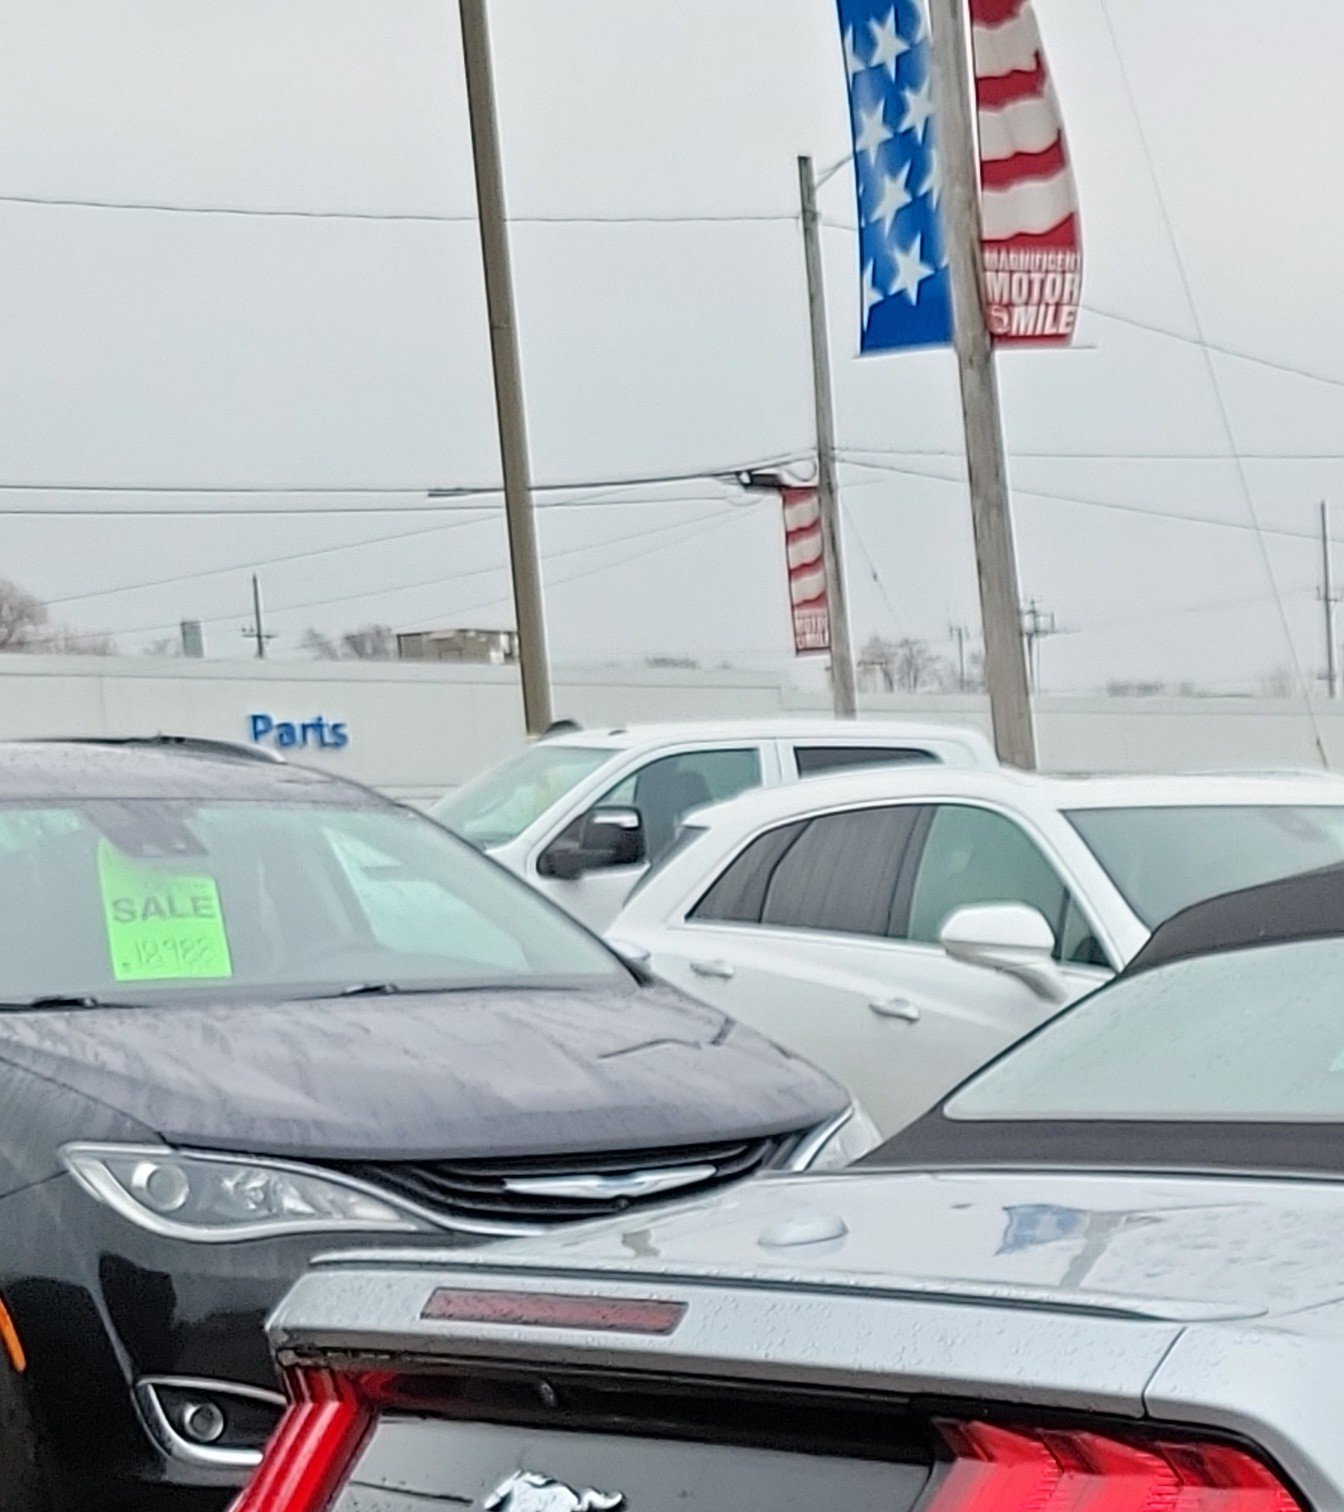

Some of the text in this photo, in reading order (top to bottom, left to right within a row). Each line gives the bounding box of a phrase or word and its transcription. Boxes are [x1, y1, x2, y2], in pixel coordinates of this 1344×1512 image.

[985, 271, 1080, 304] MOTOR
[1010, 304, 1076, 335] MILE
[251, 713, 348, 747] Parts
[112, 895, 217, 923] SALE
